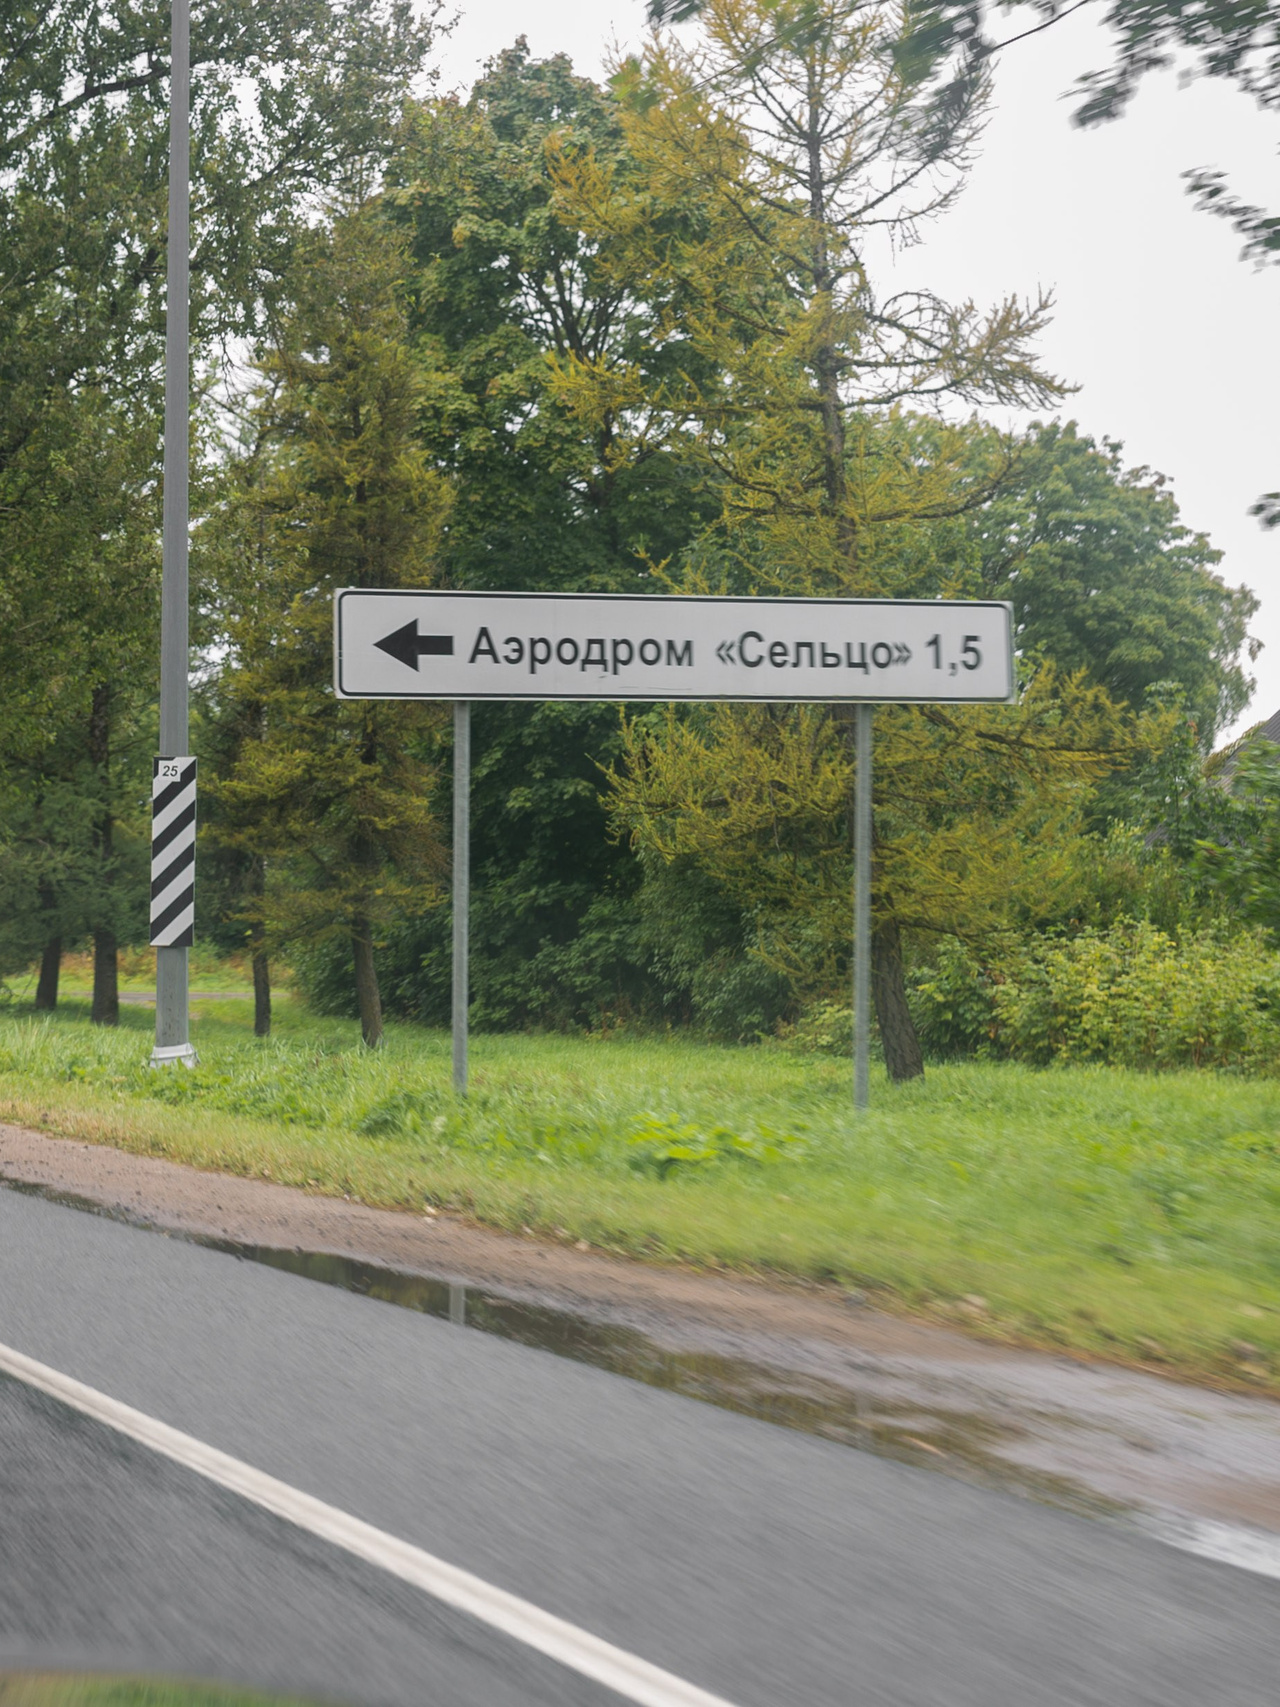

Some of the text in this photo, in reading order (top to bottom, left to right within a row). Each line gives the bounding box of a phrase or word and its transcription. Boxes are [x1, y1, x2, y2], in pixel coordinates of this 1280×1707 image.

[467, 626, 983, 677] Аэродром «Сельцо» 1,5
[162, 765, 178, 777] 25
